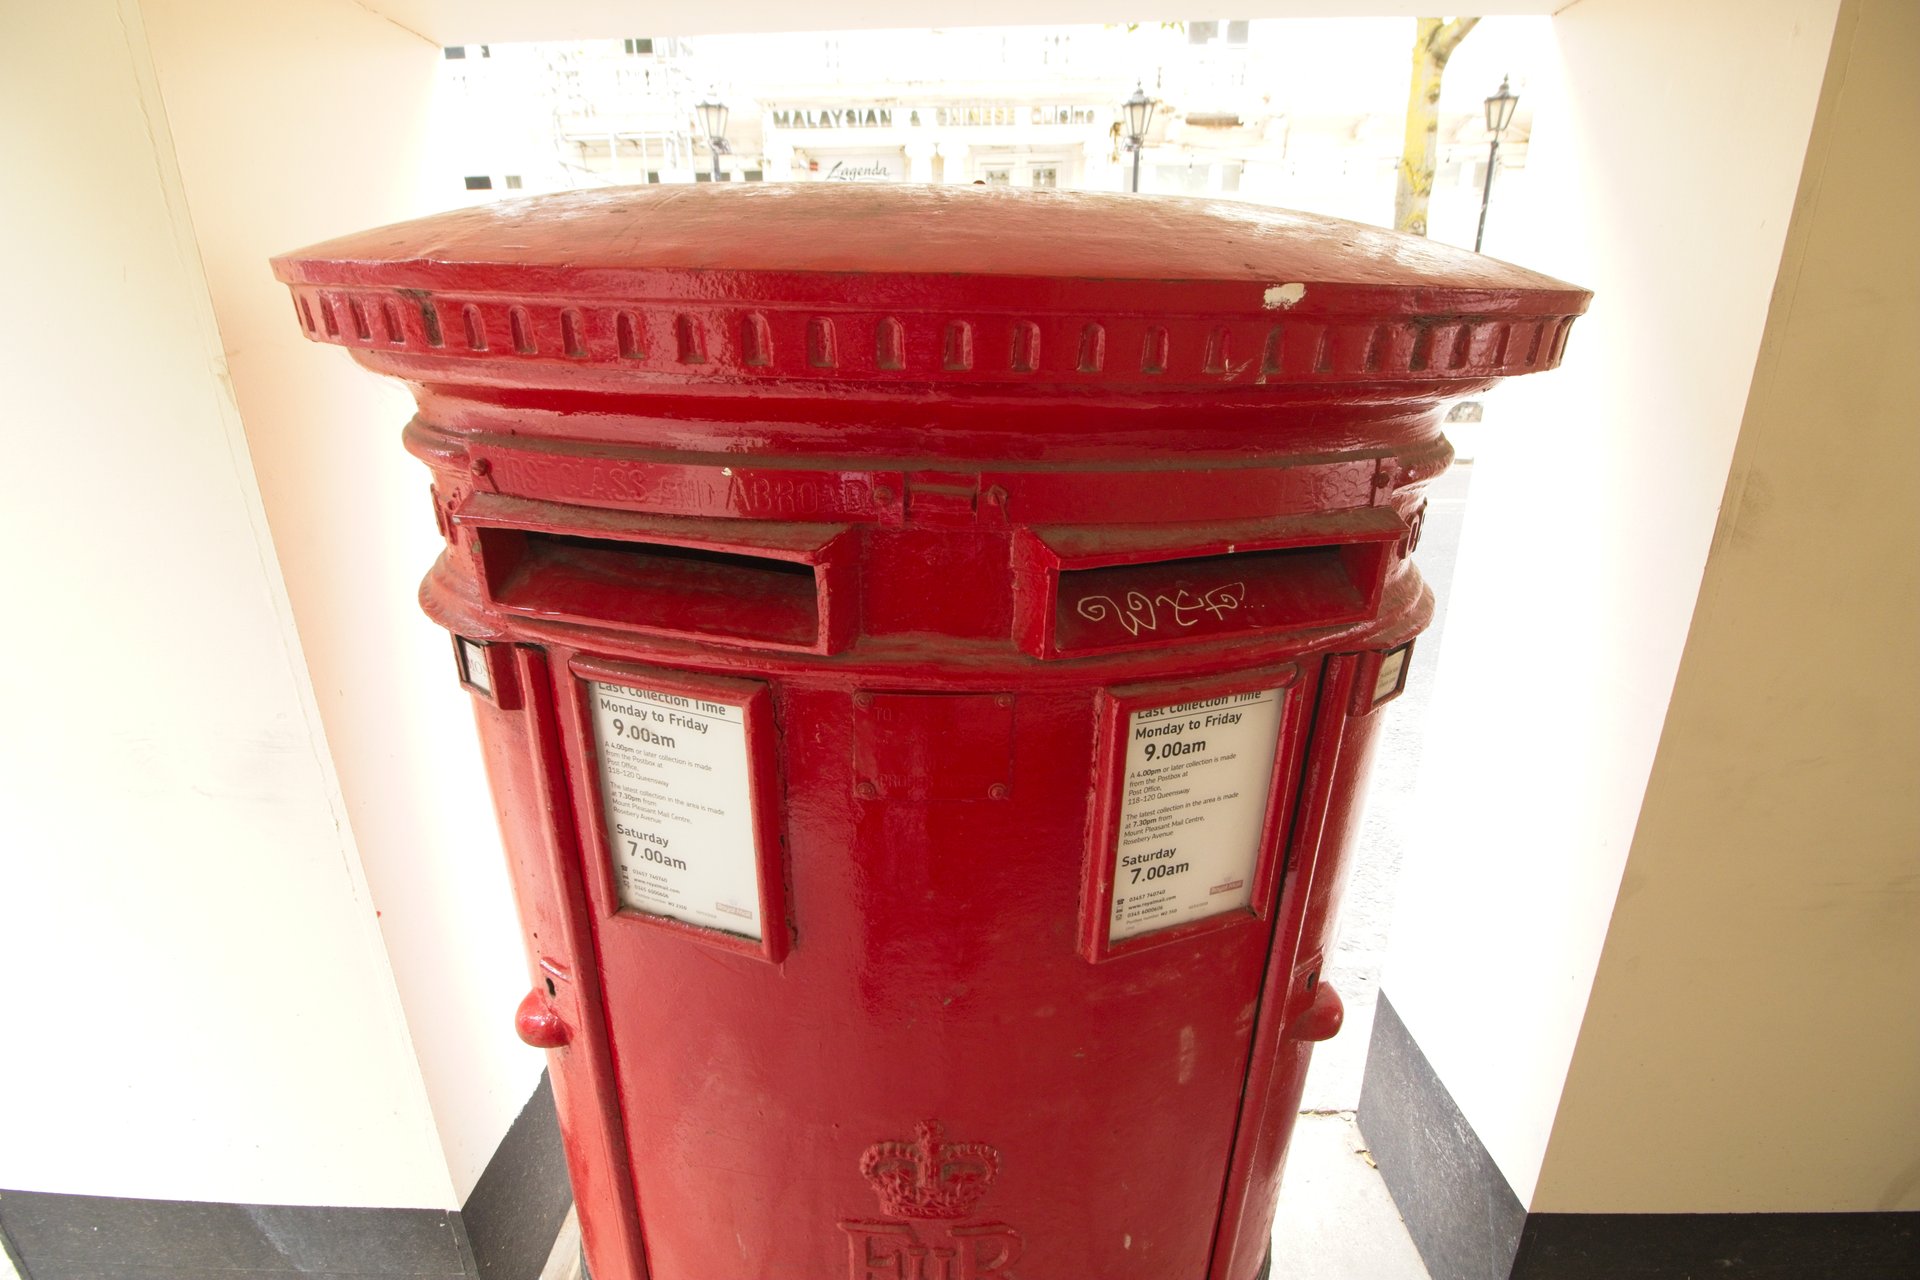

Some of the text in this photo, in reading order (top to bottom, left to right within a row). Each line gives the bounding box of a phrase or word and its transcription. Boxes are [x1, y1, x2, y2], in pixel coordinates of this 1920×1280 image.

[773, 109, 892, 128] MALAYSIAN
[910, 110, 921, 126] &
[825, 160, 890, 180] Lagenda
[600, 698, 708, 734] Monday to Friday
[1135, 712, 1242, 740] Monday to Friday
[613, 718, 675, 749] 9.00am
[1144, 740, 1206, 762] 9.00am
[1136, 768, 1162, 777] 4.00pm
[1185, 758, 1213, 768] collection
[1220, 753, 1236, 761] made
[1129, 780, 1145, 788] from
[1157, 773, 1181, 782] Postbox
[1156, 788, 1190, 799] Queensway
[1126, 813, 1138, 821] The
[1139, 809, 1156, 818] latest
[1156, 804, 1184, 814] collection
[1222, 792, 1239, 800] made
[1124, 828, 1144, 838] Mount
[1144, 822, 1170, 833] Pleasant
[1171, 819, 1184, 827] Mail
[1133, 818, 1157, 828] 7.30pm
[1158, 814, 1173, 822] from
[616, 823, 669, 848] Saturday
[1122, 831, 1174, 846] Rosebery Avenue
[627, 840, 687, 871] 7.00am
[1122, 848, 1177, 867] Saturday
[1130, 862, 1189, 885] 7.00am
